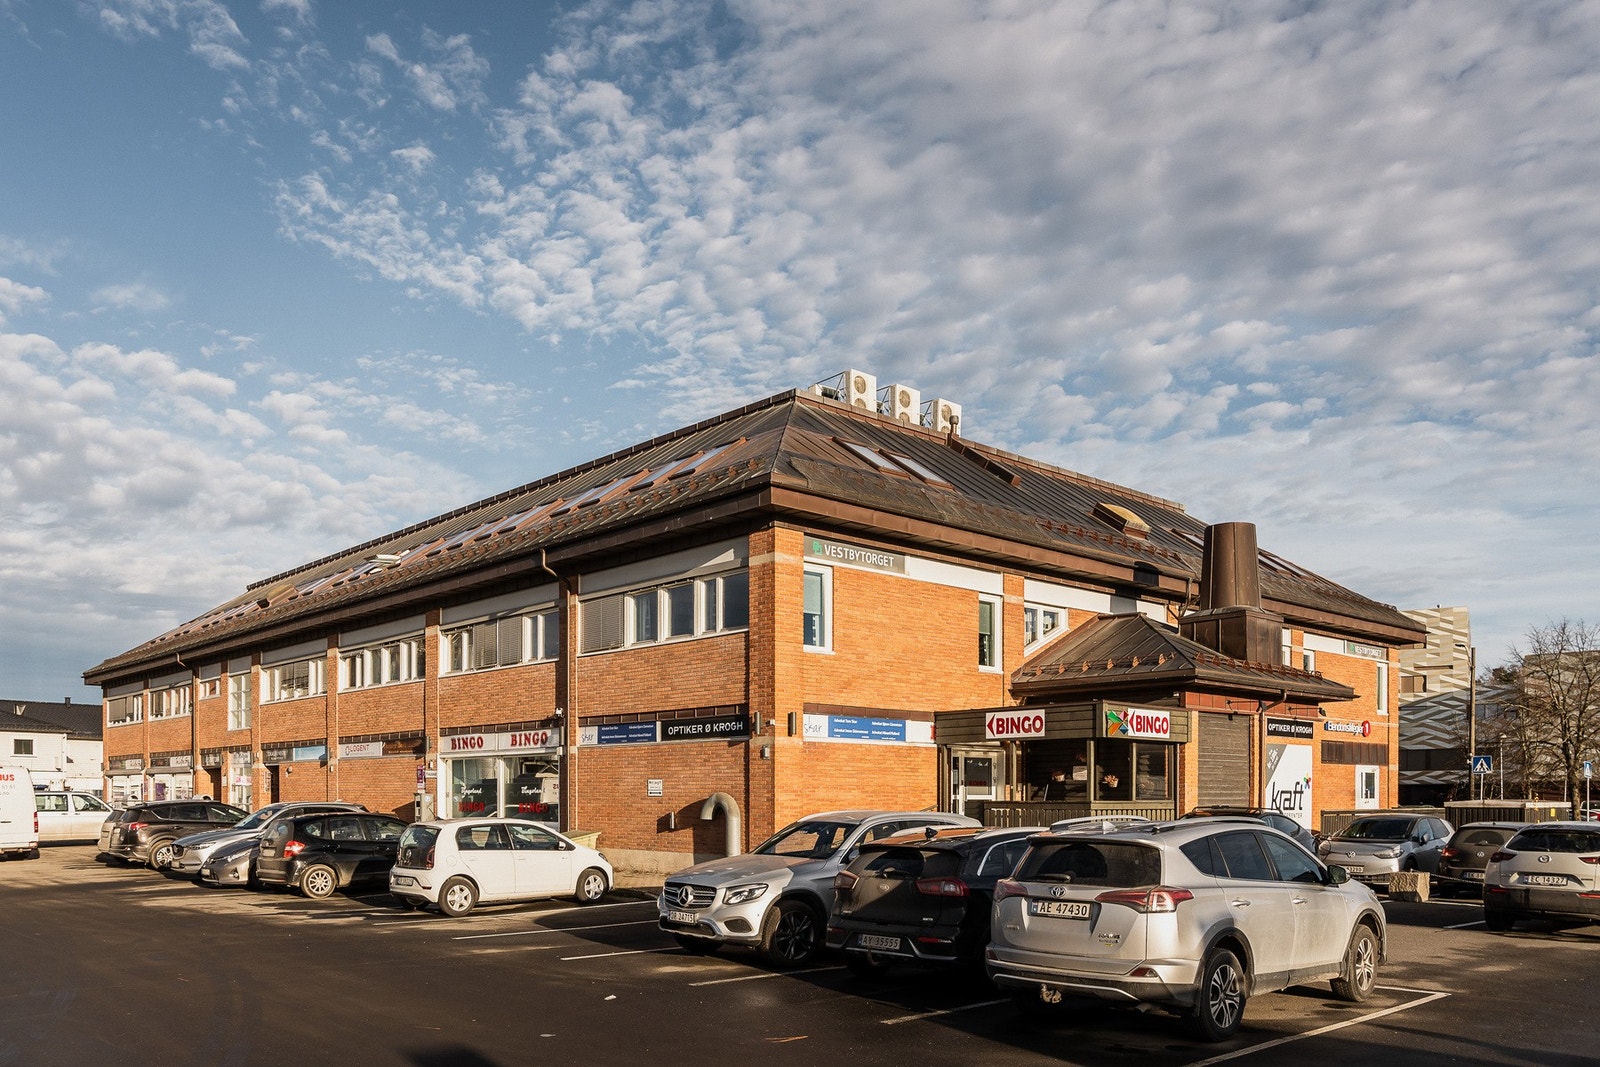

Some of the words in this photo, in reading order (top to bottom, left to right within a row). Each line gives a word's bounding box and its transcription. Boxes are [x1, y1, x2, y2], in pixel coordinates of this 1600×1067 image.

[824, 544, 894, 567] VESTBYTORGET
[667, 724, 703, 735] OPTIKER
[705, 723, 711, 733] Ø
[713, 721, 743, 732] KROGH
[996, 715, 1043, 734] BINGO
[1136, 715, 1168, 734] BINGO
[1268, 723, 1290, 732] OPTIKER
[1296, 725, 1312, 734] KROGH
[451, 736, 484, 750] BINGO
[511, 731, 548, 747] BINGO
[1271, 782, 1304, 811] kraft
[458, 802, 485, 812] BINGO
[518, 802, 549, 814] BINGO
[1040, 902, 1052, 913] AE
[1056, 902, 1088, 916] 47430
[863, 935, 873, 945] AY
[875, 936, 898, 948] 35555
